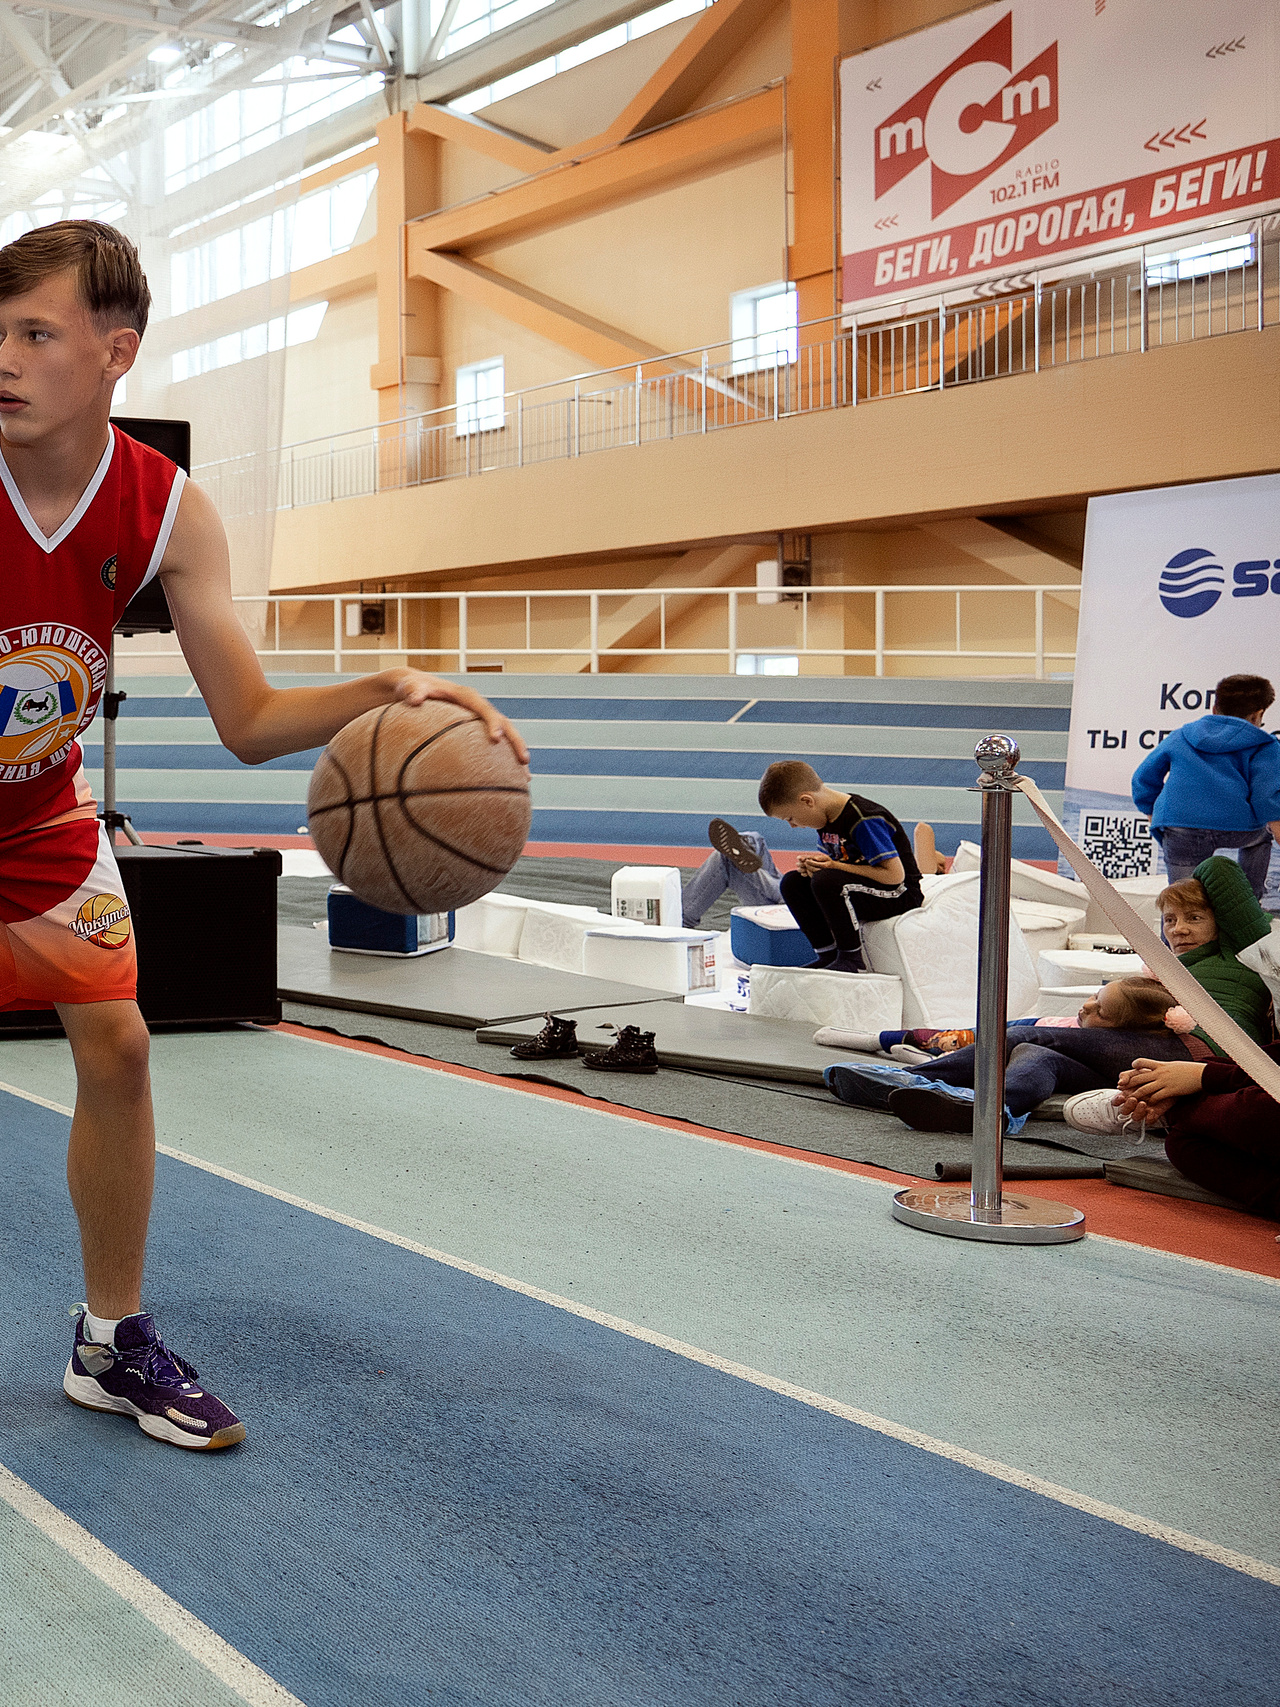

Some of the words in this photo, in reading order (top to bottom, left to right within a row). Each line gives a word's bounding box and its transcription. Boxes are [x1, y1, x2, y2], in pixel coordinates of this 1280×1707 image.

[1015, 158, 1059, 179] RADIO
[989, 180, 1027, 204] 102.1
[1032, 171, 1060, 193] FM
[873, 236, 958, 288] БЕГИ,
[968, 188, 1136, 270] ДОРОГАЯ,
[1148, 149, 1268, 219] БЕГИ!
[1087, 729, 1128, 750] ты
